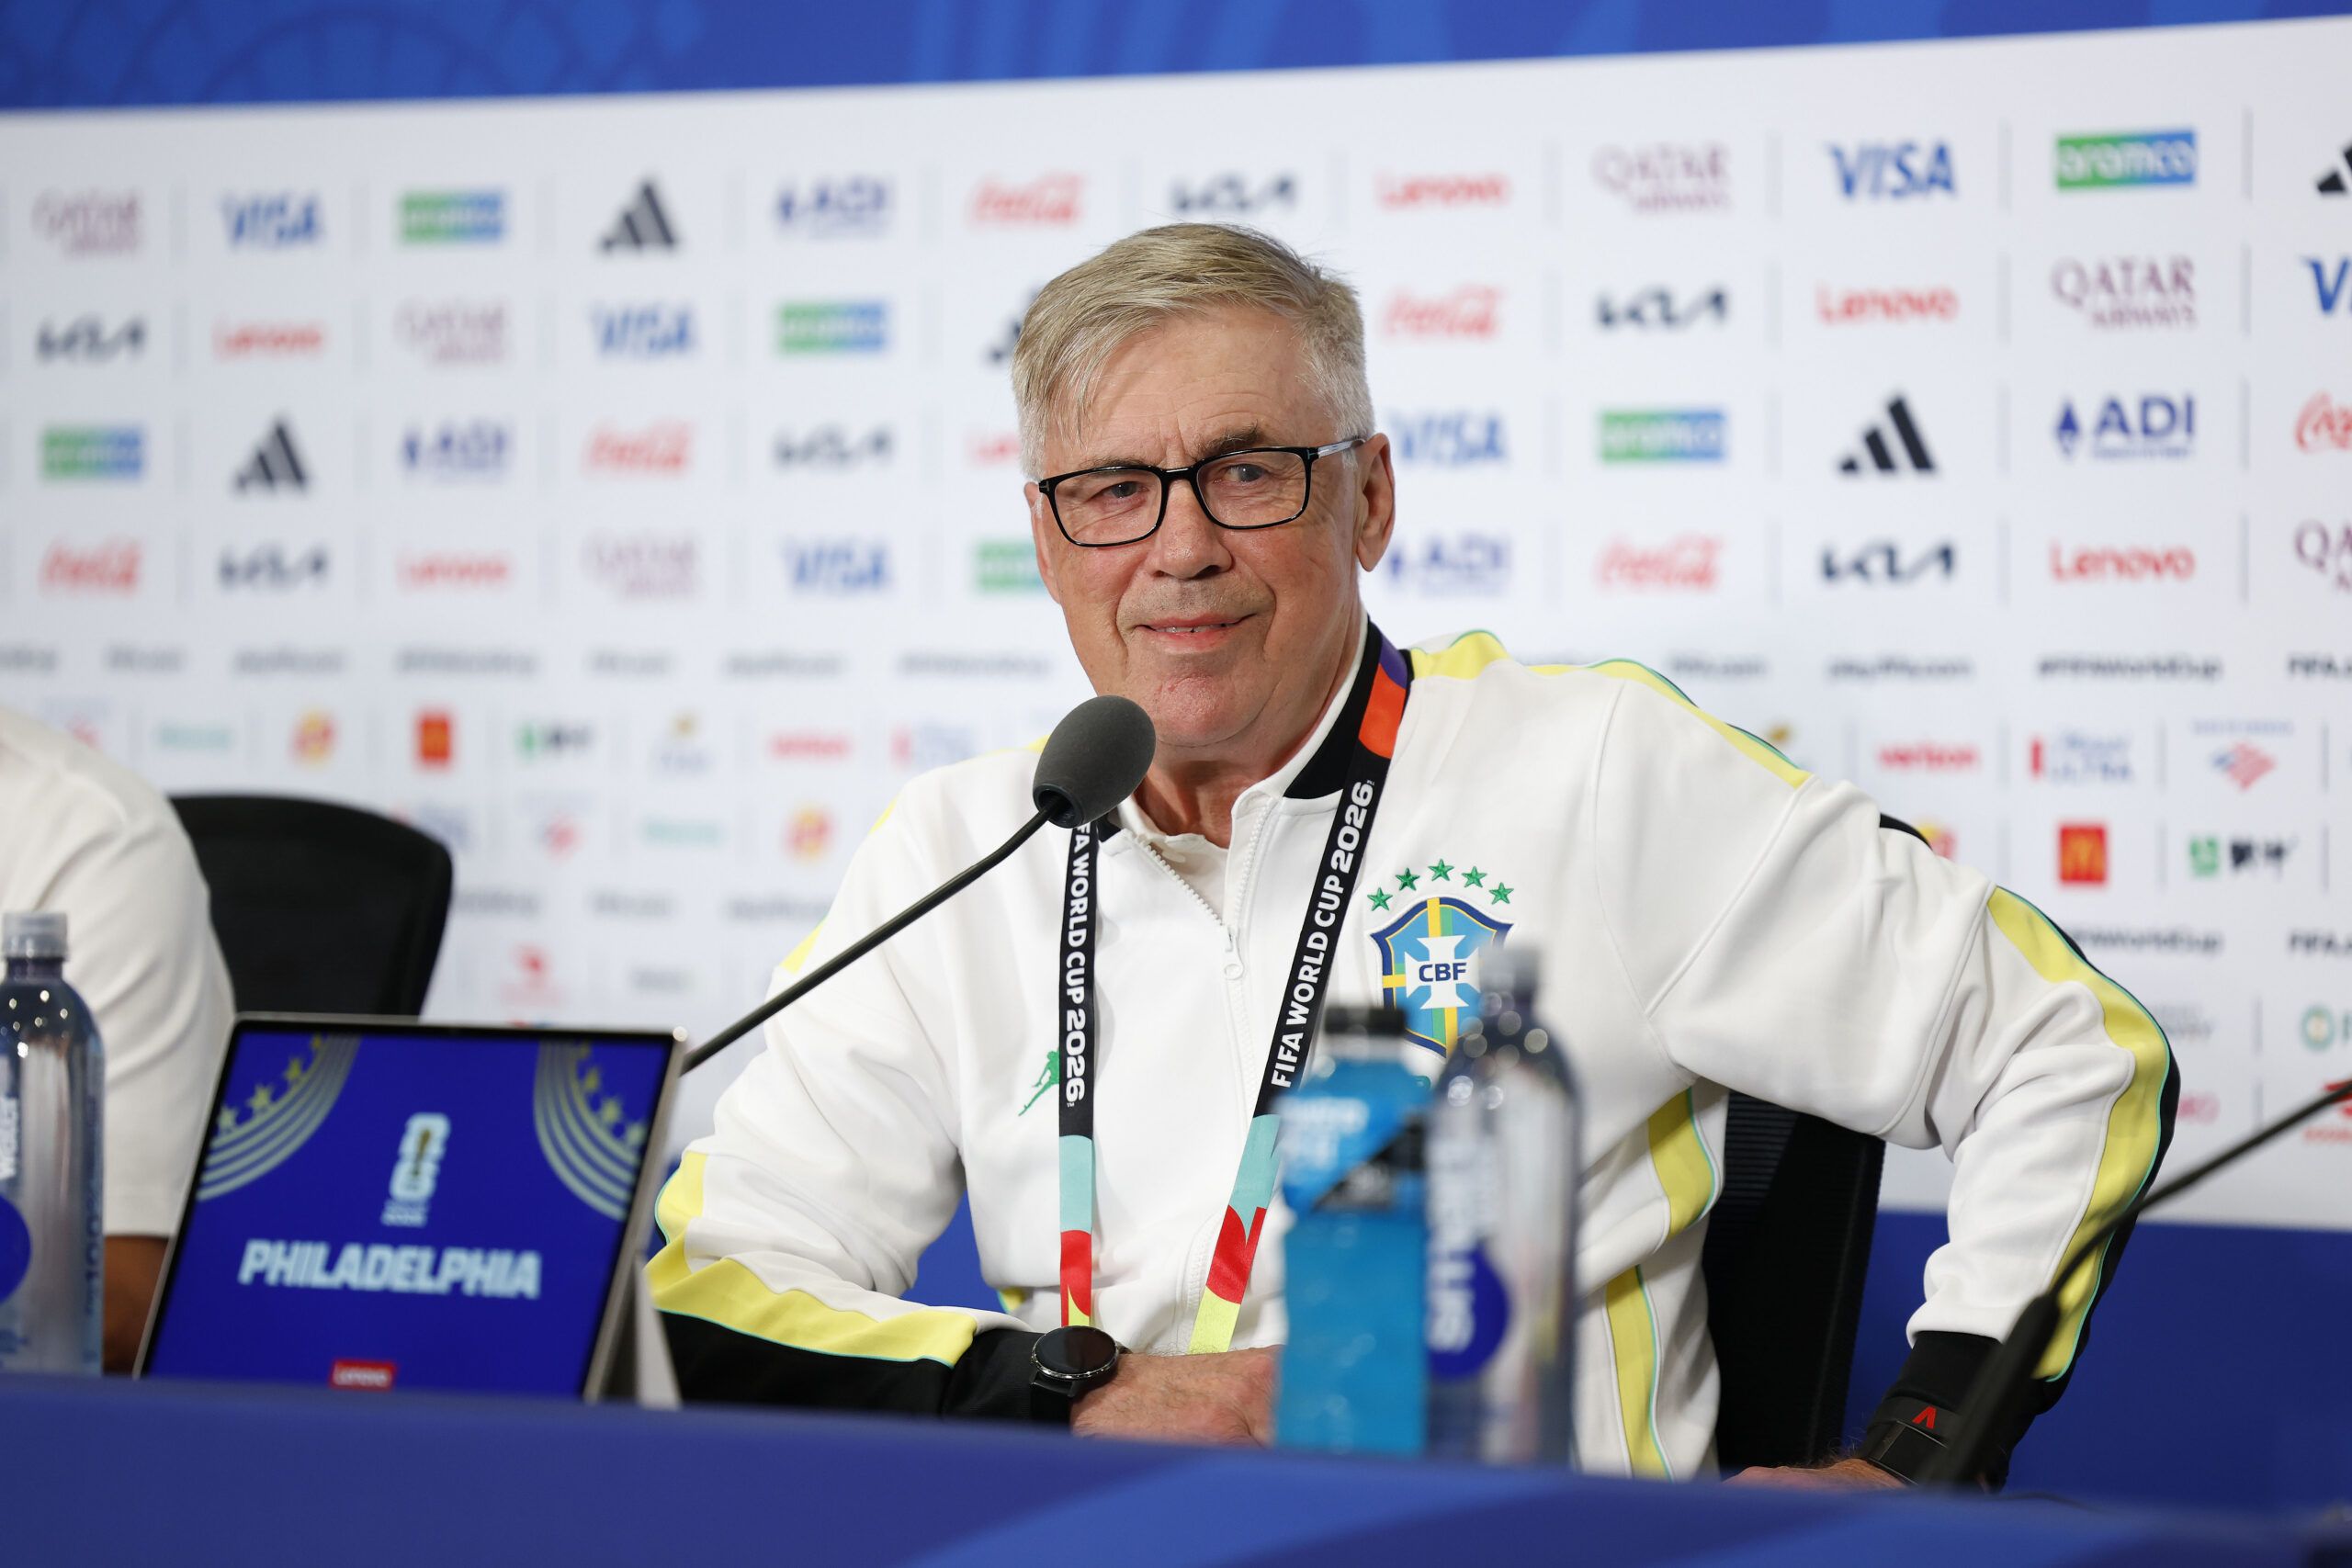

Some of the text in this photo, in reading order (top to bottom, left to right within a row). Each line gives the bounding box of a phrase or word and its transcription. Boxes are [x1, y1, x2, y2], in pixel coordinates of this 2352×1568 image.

[1829, 141, 1959, 199] VISA
[1817, 285, 1959, 324] Lenovo
[2052, 256, 2195, 309] QATAR
[2093, 395, 2196, 438] ADI
[2052, 547, 2196, 581] Lenovo
[1074, 822, 1091, 852] FA
[1068, 852, 1090, 947] WORLD
[1314, 874, 1344, 928] CUP
[1066, 952, 1086, 1004] CUP
[1286, 931, 1329, 1025] WORLD
[1419, 962, 1467, 983] CBF
[1272, 1032, 1304, 1088] FIFA
[240, 1240, 541, 1300] PHILADELPHIA
